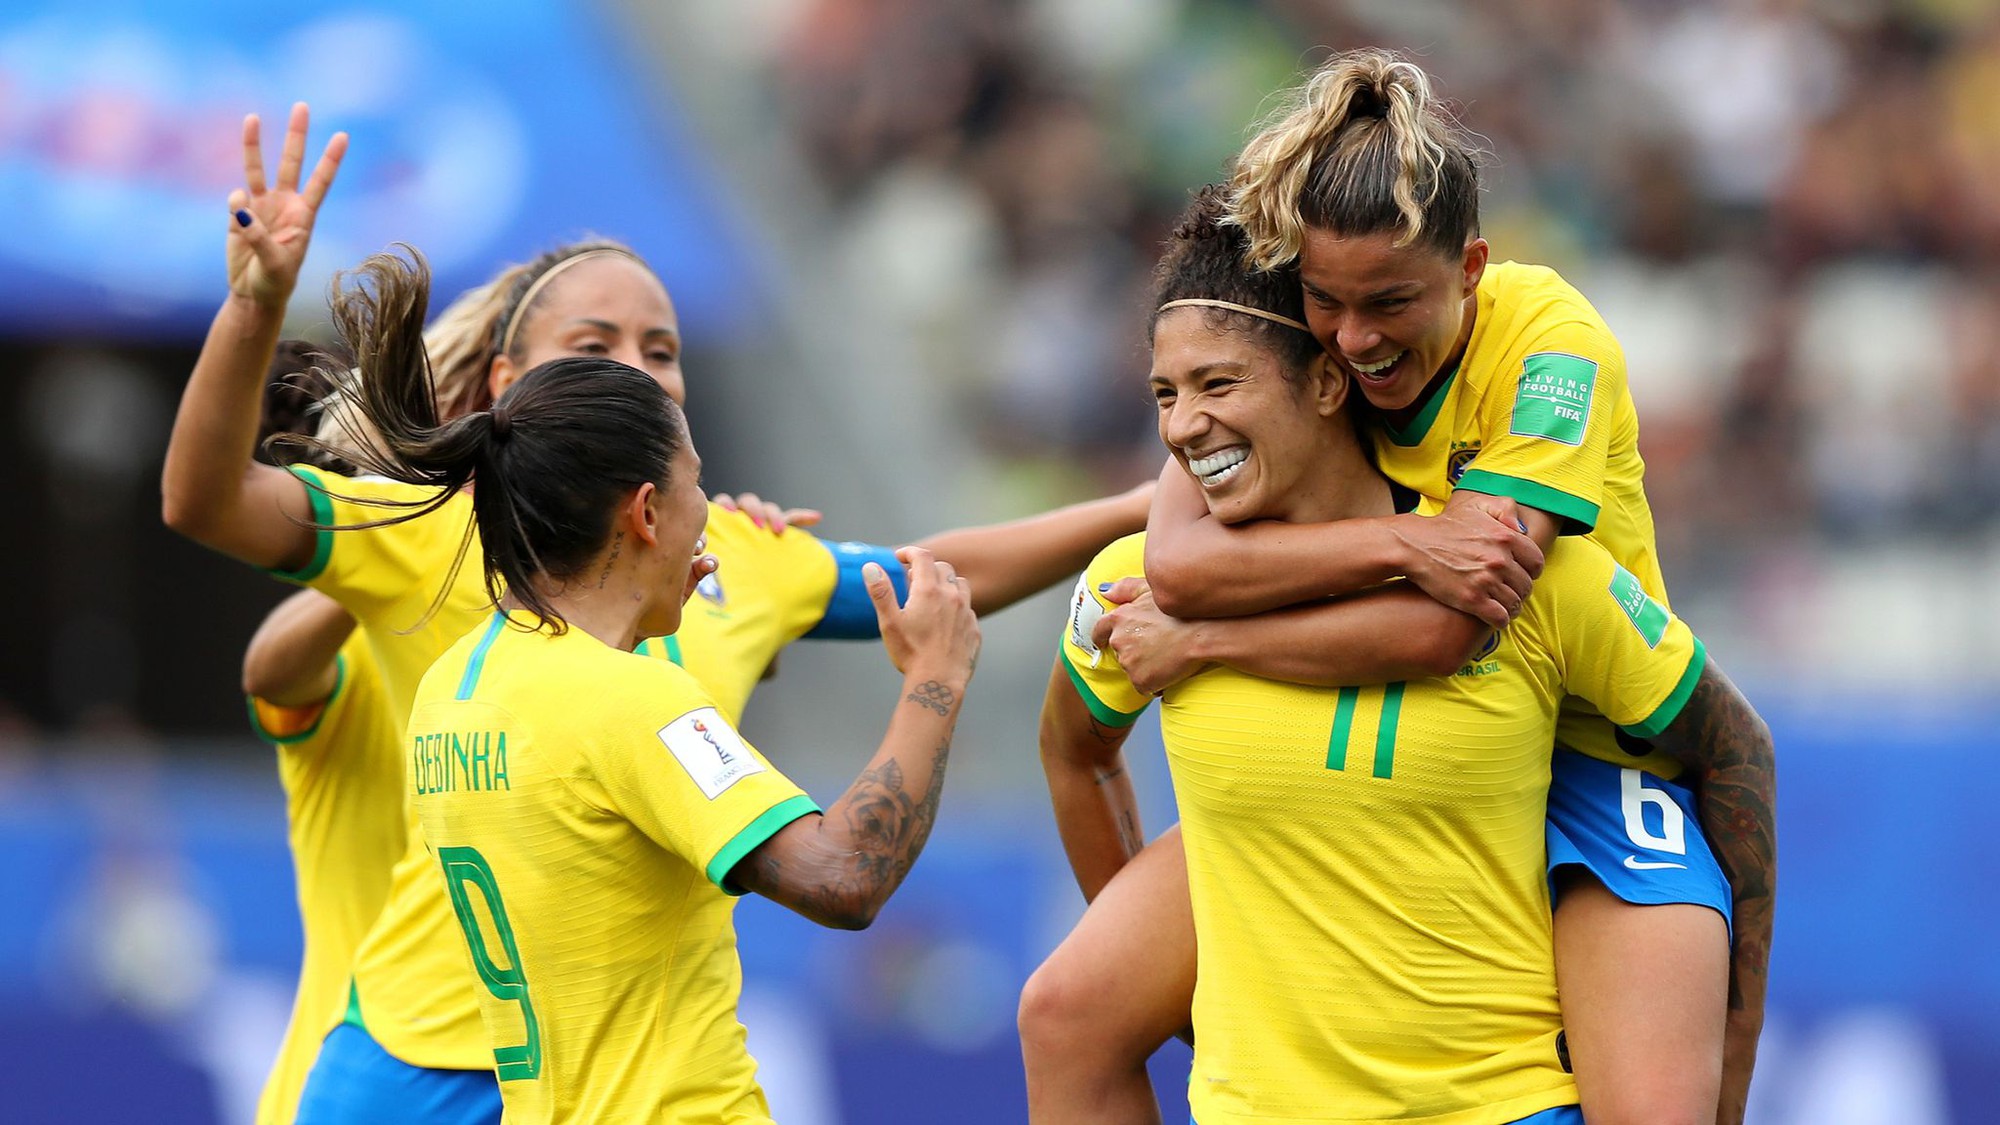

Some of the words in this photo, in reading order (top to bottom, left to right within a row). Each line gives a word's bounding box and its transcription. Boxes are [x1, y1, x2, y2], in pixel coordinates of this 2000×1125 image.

[1523, 383, 1585, 401] FOOTBALL
[1525, 374, 1588, 392] LIVING
[1554, 406, 1581, 422] FIFA
[1326, 680, 1406, 779] 11
[414, 731, 510, 795] DEBINHA
[1621, 768, 1686, 856] 6
[438, 846, 542, 1082] 9
